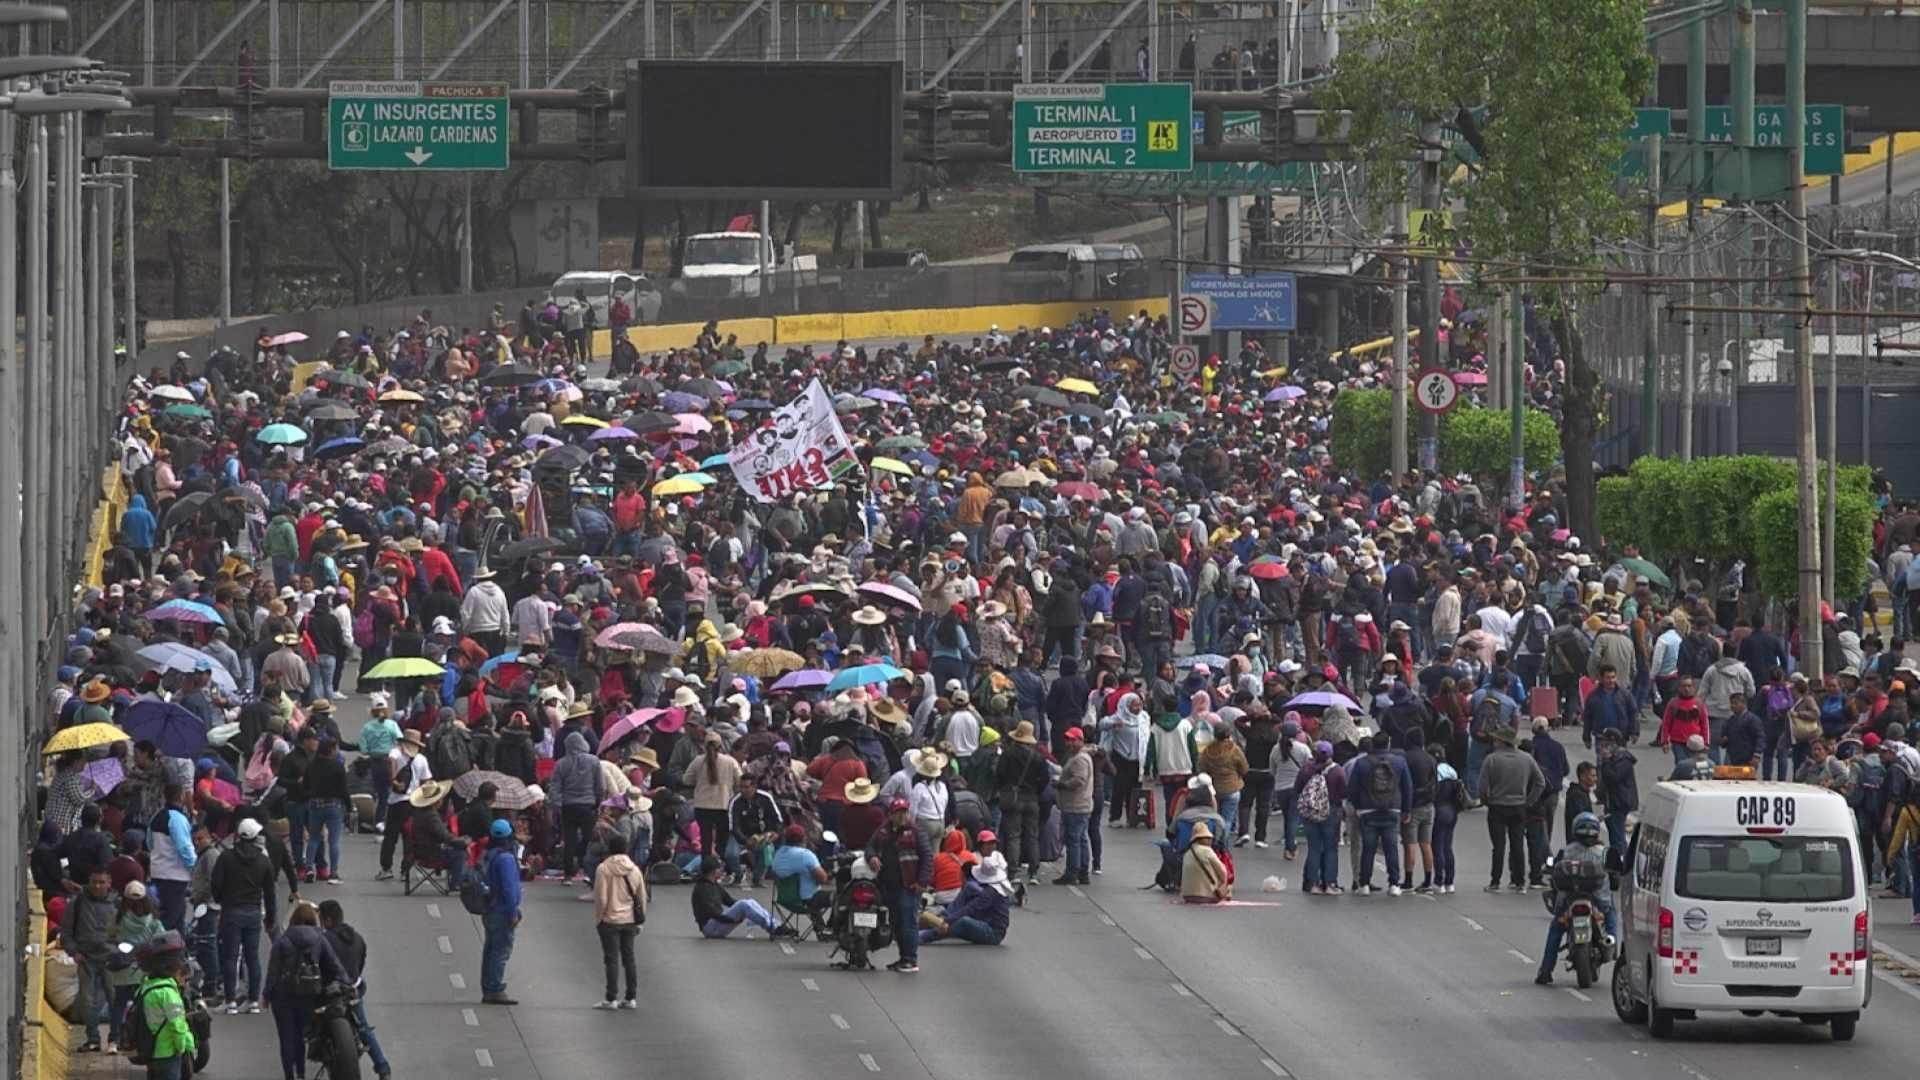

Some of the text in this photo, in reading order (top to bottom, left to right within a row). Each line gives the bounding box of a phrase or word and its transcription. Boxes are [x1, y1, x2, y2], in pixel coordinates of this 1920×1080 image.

[432, 87, 484, 96] PACHUCA
[1016, 86, 1100, 95] CIRCUITO BICENTENARIO
[342, 103, 497, 120] AV INSURGENTES
[1034, 105, 1136, 123] TERMINAL 1
[374, 126, 497, 143] LAZARO CARDENAS
[1033, 129, 1118, 141] AEROPUERTO
[1028, 148, 1136, 165] TERMINAL 2
[1737, 796, 1796, 826] CAP 89
